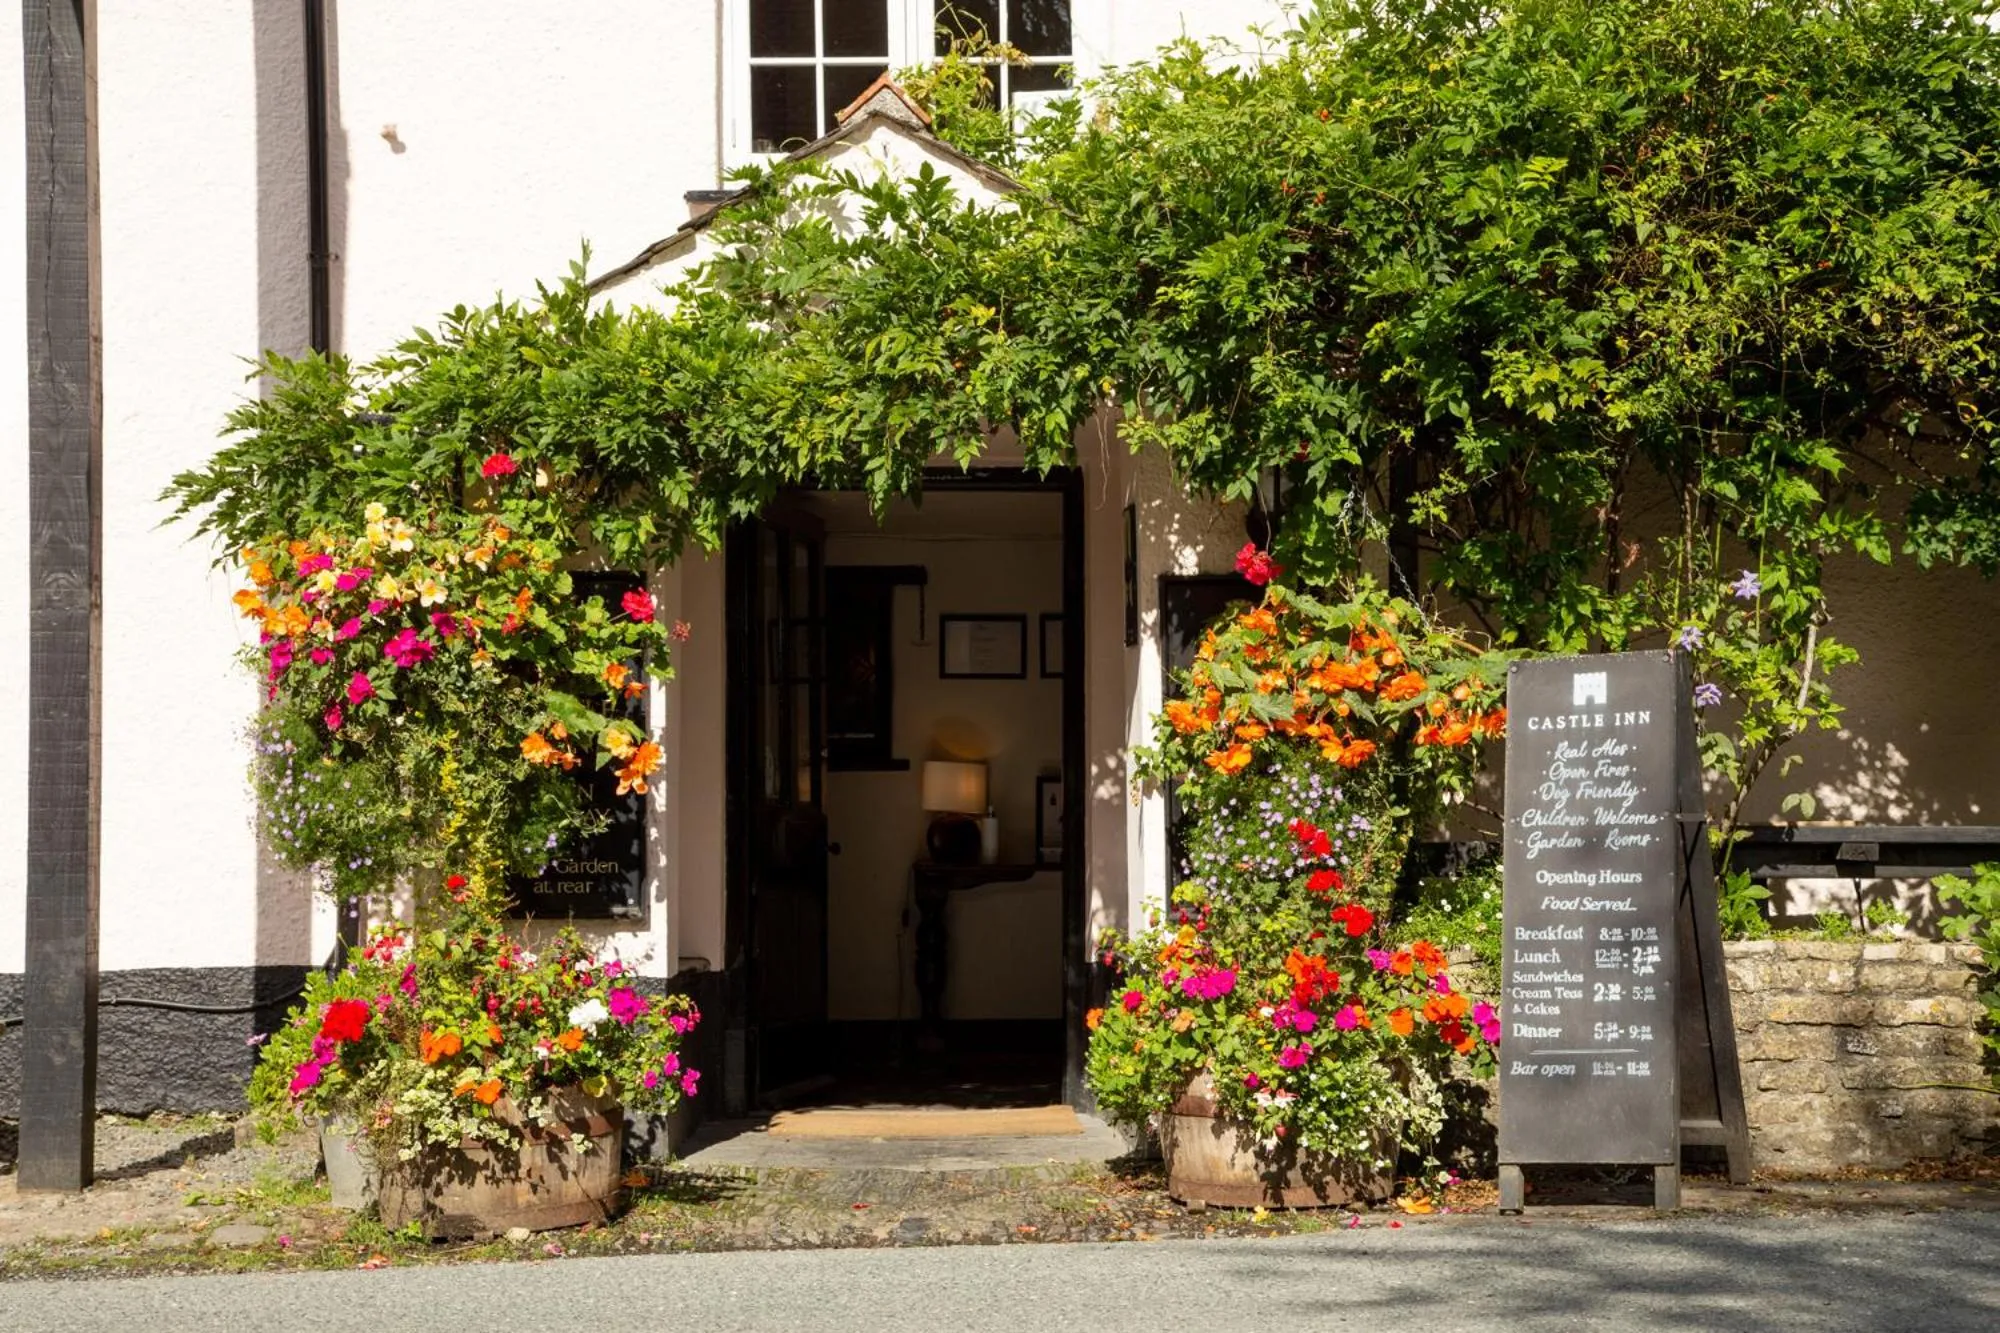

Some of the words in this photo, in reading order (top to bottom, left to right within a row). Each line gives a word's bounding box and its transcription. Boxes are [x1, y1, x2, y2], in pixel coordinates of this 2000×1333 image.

[1528, 714, 1604, 730] CASTLE
[1614, 711, 1652, 725] INN
[1553, 741, 1587, 759] Real
[1592, 739, 1629, 758] Ales
[1549, 764, 1590, 785] Open
[1594, 760, 1630, 777] Fires
[1539, 783, 1570, 809] Dog
[1576, 780, 1639, 806] Friendly
[1521, 809, 1587, 828] Children
[1594, 806, 1658, 825] Welcome
[1527, 832, 1585, 859] Garden
[1604, 829, 1651, 850] Rooms
[556, 858, 619, 874] Garden
[1536, 871, 1596, 887] Opening
[1598, 871, 1642, 883] Hours
[533, 881, 552, 894] at
[557, 882, 594, 894] rear
[1541, 896, 1578, 910] Food
[1515, 925, 1584, 941] Breakfast
[1514, 949, 1560, 964] Lunch
[1513, 971, 1584, 983] Sandwiches
[1512, 987, 1552, 1000] Cream
[1554, 987, 1583, 999] Teas
[1524, 1003, 1560, 1014] Cakes
[1513, 1024, 1562, 1038] Dinner
[1511, 1062, 1538, 1075] Bar
[1541, 1064, 1576, 1076] open
